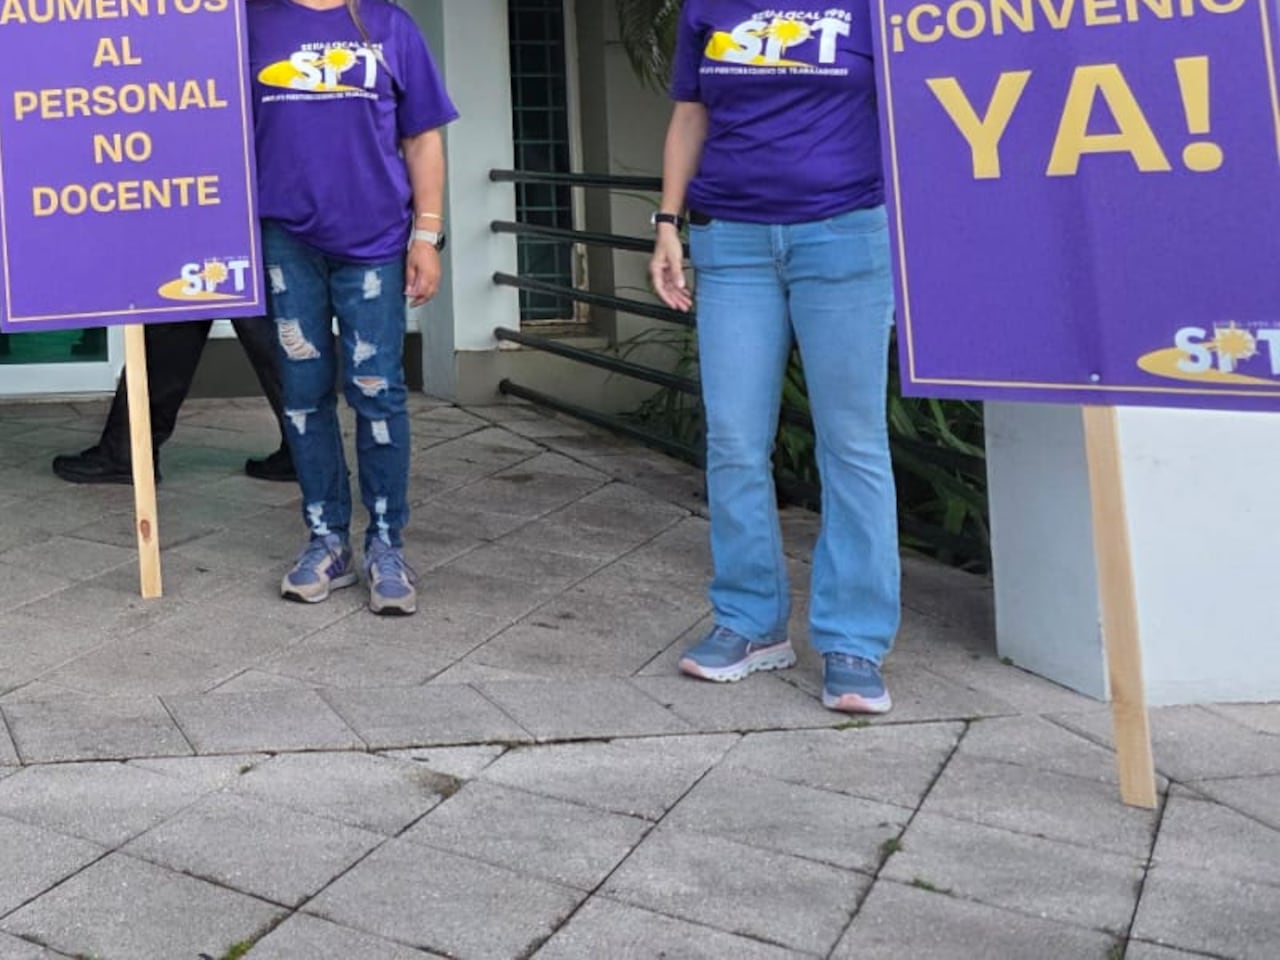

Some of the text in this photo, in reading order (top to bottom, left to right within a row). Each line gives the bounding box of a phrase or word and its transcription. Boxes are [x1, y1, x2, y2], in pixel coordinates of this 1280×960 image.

[93, 36, 141, 67] AL
[731, 18, 851, 66] SPT
[290, 48, 382, 91] SPT
[13, 79, 228, 119] PERSONAL
[924, 55, 1225, 178] YA!
[93, 131, 154, 163] NO
[31, 175, 220, 217] DOCENTE
[181, 259, 250, 295] SPT
[1175, 326, 1280, 376] SPT
